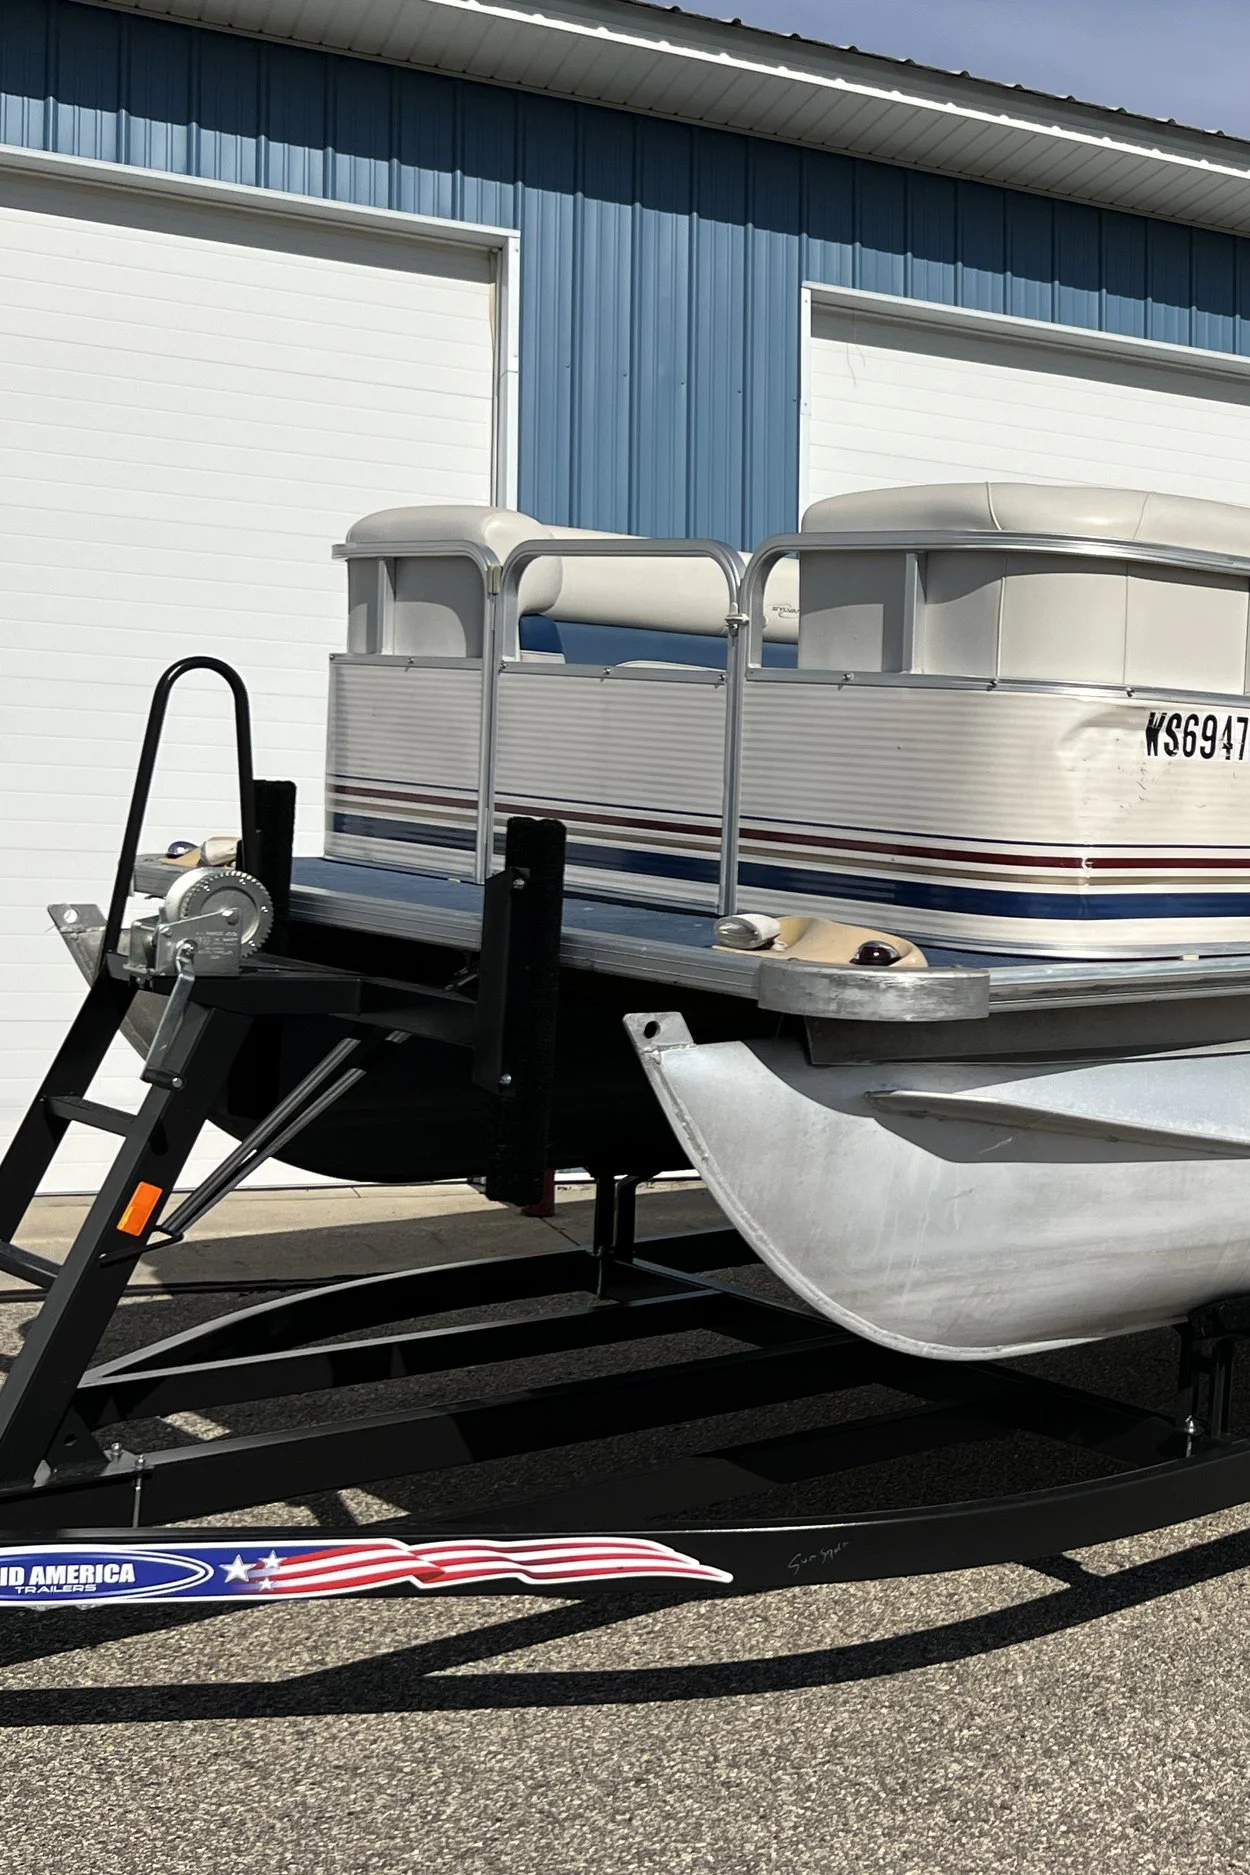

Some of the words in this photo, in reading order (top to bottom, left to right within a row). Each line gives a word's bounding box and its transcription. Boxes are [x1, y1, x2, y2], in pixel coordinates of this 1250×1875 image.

[772, 606, 800, 614] SYLVA
[0, 1566, 25, 1586] ID
[29, 1563, 136, 1586] AMERICA
[15, 1584, 97, 1594] TRAILERS
